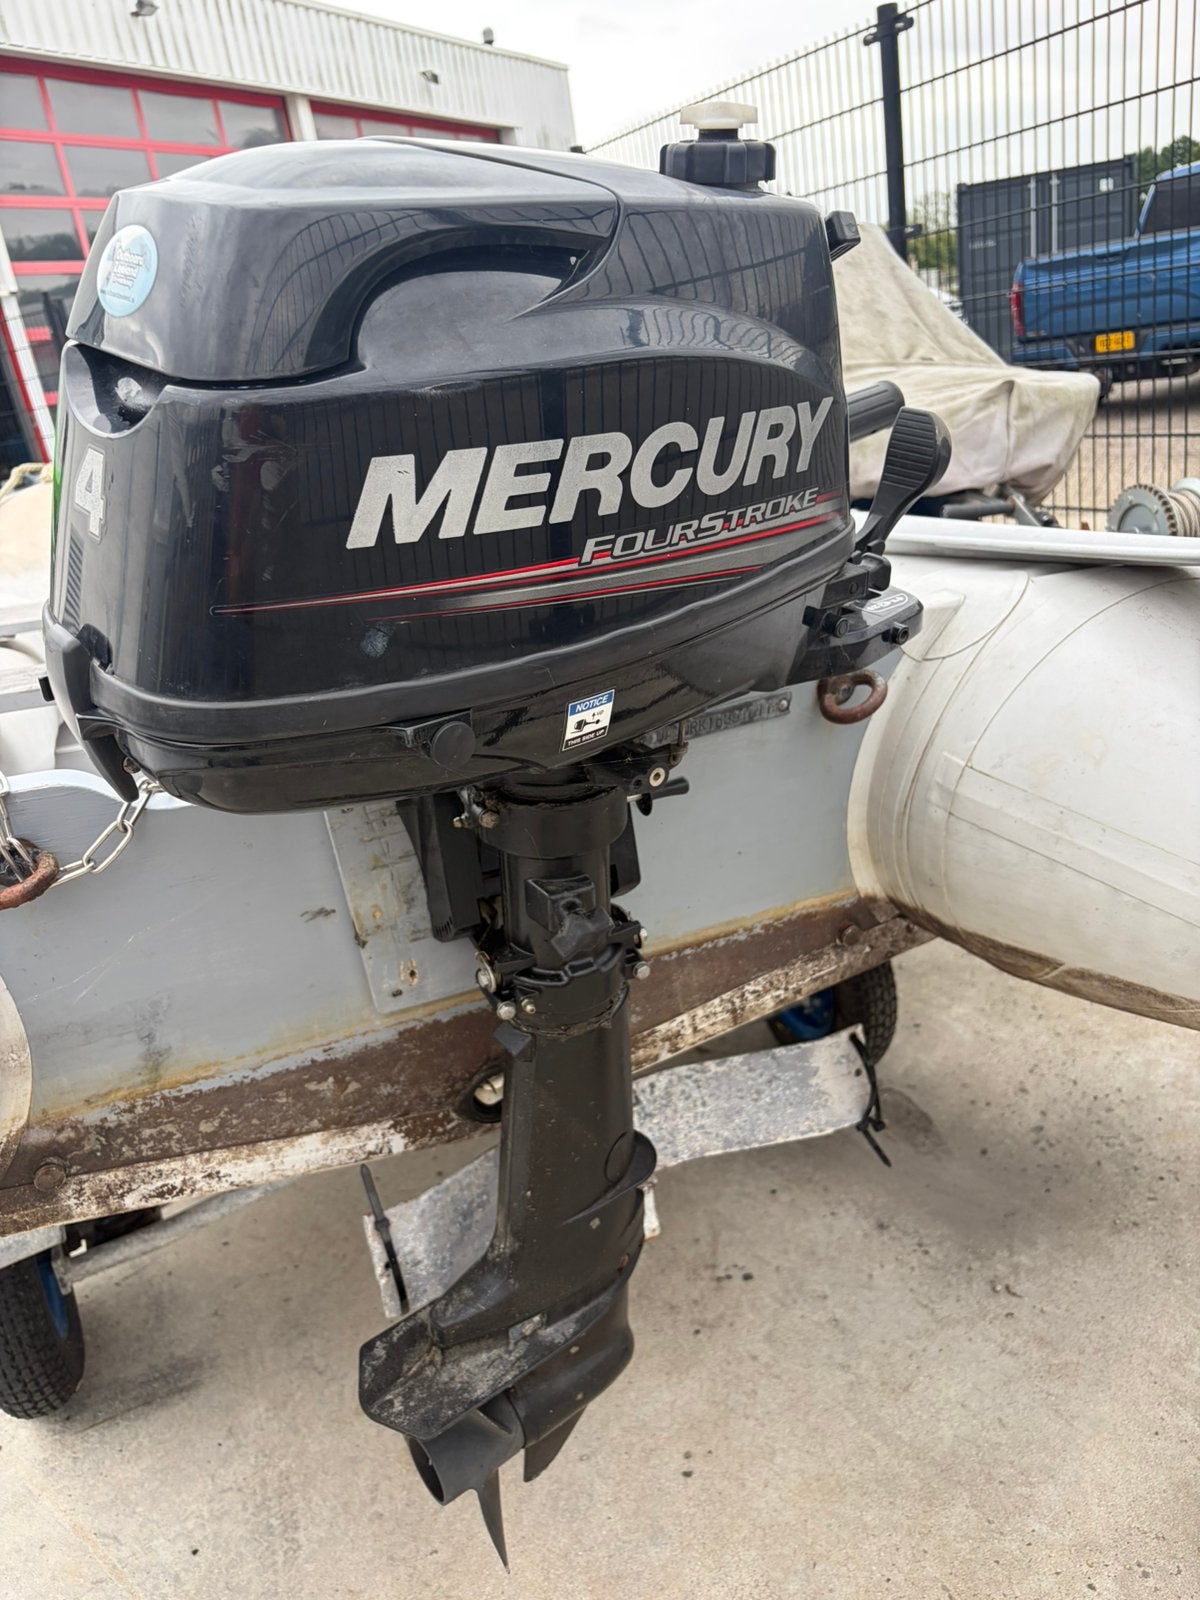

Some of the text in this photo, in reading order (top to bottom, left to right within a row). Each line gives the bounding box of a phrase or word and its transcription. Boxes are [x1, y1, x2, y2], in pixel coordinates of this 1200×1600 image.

[74, 446, 105, 540] 4
[345, 396, 834, 550] MERCURY
[580, 487, 820, 565] FOURSTROKE
[568, 728, 605, 746] THIS SIDE UP
[575, 694, 609, 713] NOTICE
